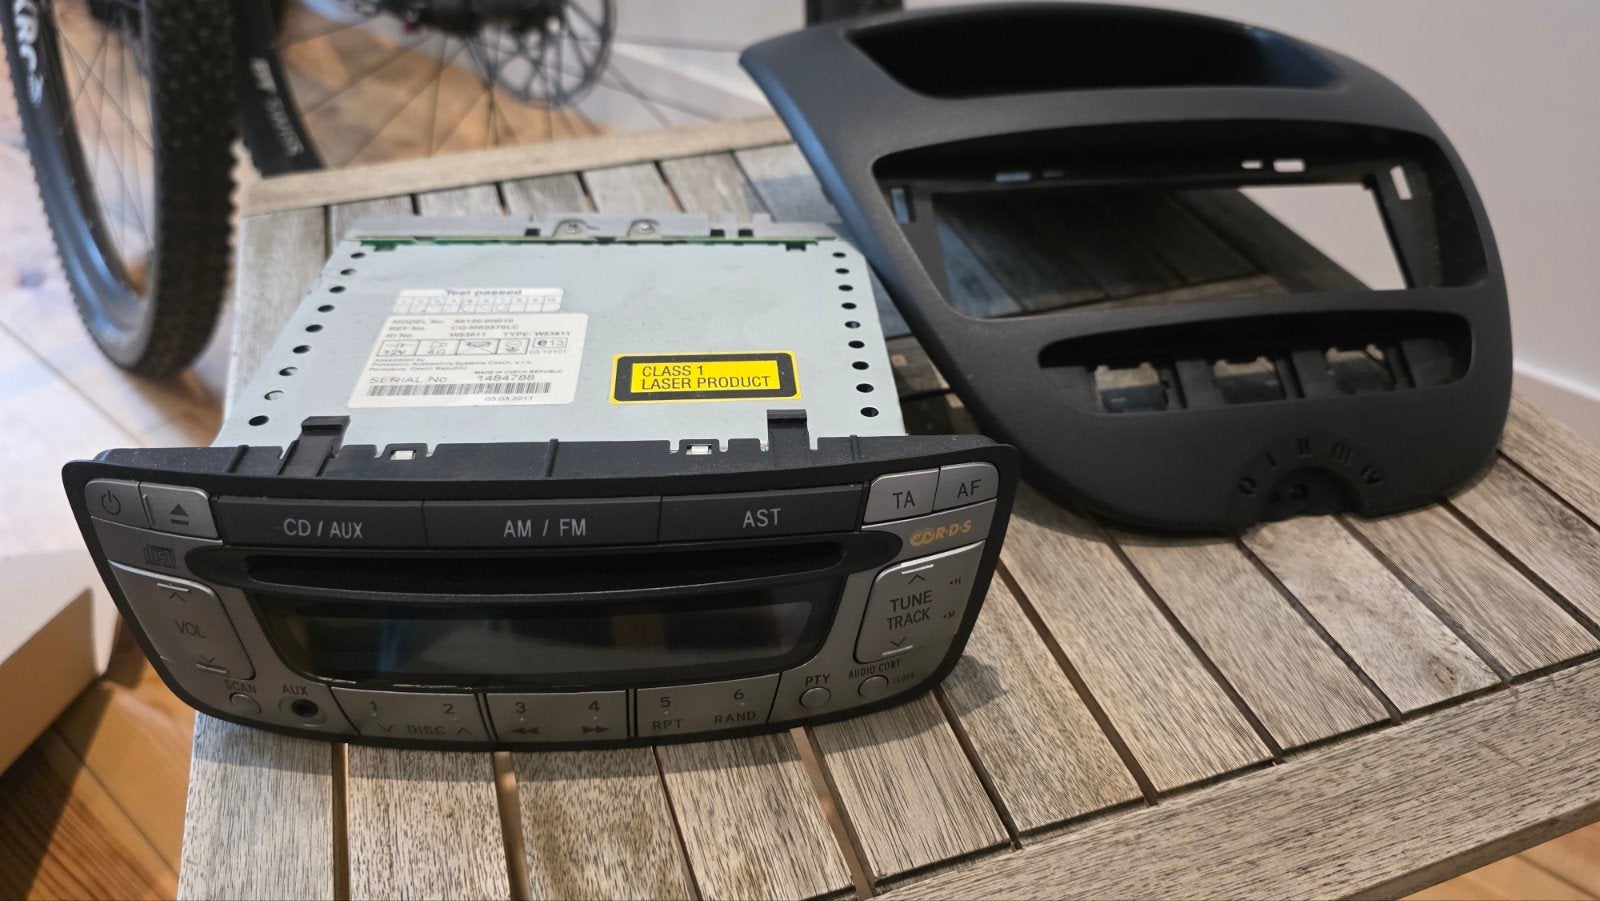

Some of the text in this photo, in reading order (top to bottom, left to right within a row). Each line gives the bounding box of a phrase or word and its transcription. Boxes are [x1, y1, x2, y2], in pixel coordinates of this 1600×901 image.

[474, 289, 522, 297] passed
[642, 365, 704, 377] CLASS 1
[369, 376, 422, 384] SERIAL
[641, 375, 771, 390] LASER PRODUCT
[956, 479, 982, 499] AF
[892, 490, 916, 510] TA
[743, 508, 782, 529] AST
[283, 518, 312, 537] CD
[329, 521, 364, 539] AUX
[503, 519, 532, 538] AM
[559, 518, 587, 538] FM
[889, 589, 933, 613] TUNE
[886, 607, 931, 631] TRACK
[174, 619, 207, 639] VOL
[848, 659, 901, 680] AUDIO CONT
[223, 679, 258, 694] SCAN
[805, 673, 831, 687] PTY
[282, 684, 309, 697] AUX
[733, 688, 745, 701] 6
[370, 700, 379, 712] 1
[442, 703, 456, 715] 2
[514, 702, 528, 714] 3
[588, 701, 601, 712] 4
[660, 696, 672, 708] 5
[652, 718, 684, 731] RPT
[714, 710, 757, 725] RAND
[406, 723, 447, 736] DISC
